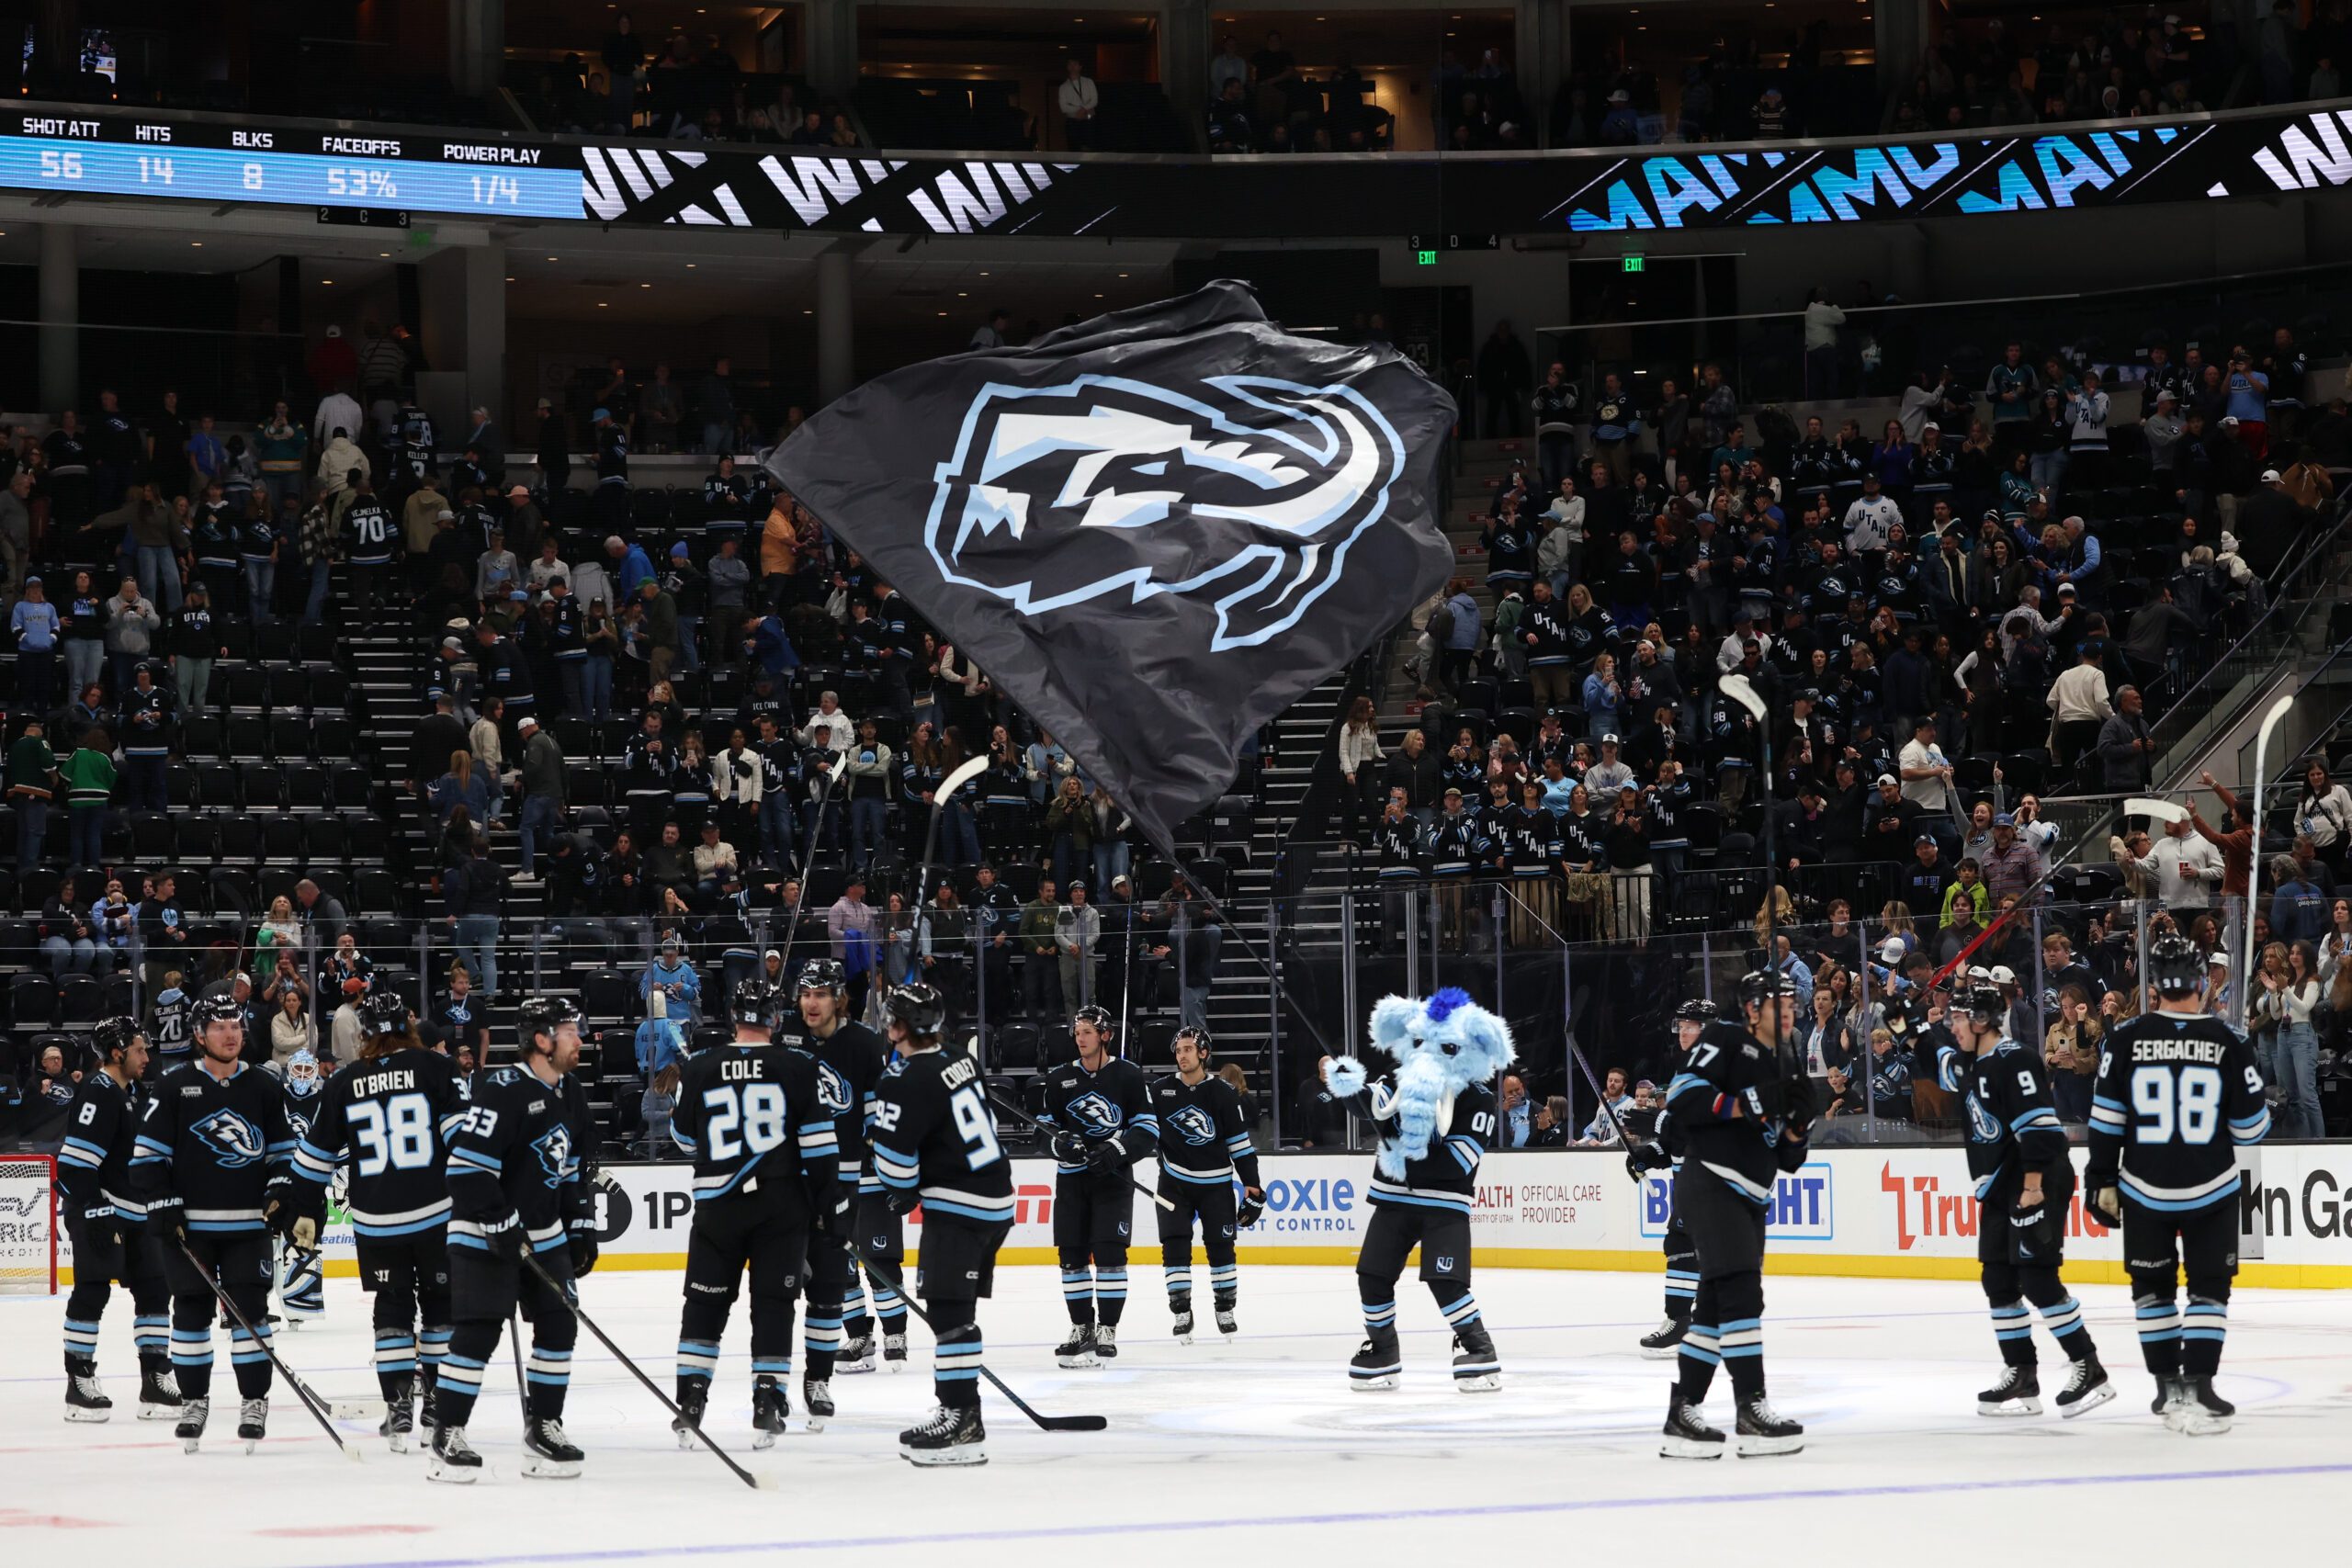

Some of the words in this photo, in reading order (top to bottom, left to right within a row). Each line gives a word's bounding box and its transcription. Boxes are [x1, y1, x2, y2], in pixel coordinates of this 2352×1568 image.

[22, 118, 66, 136] SHOT
[68, 120, 100, 138] ATT
[135, 125, 171, 142] HITS
[232, 131, 273, 148] BLKS
[322, 137, 401, 156] FACEOFFS
[444, 144, 499, 163] POWER
[501, 147, 540, 164] PLAY
[40, 151, 84, 179] 56
[137, 156, 175, 185] 14
[243, 163, 264, 190] 8
[327, 168, 397, 198] 53%
[470, 175, 521, 205] 1/4
[322, 208, 329, 221] 2
[359, 209, 368, 223] C
[398, 211, 407, 225] 3
[1411, 235, 1419, 248] 3
[1450, 235, 1459, 247] D
[1487, 234, 1497, 247] 4
[1419, 251, 1436, 265] EXIT
[1624, 257, 1643, 272] EXIT
[2004, 478, 2015, 489] 71
[352, 516, 386, 544] 70
[1859, 510, 1886, 538] UTAH
[184, 612, 210, 624] UTAH
[560, 611, 567, 621] 8
[1534, 613, 1566, 642] UTAH
[1778, 637, 1798, 661] UTAH
[435, 671, 440, 681] 9
[153, 698, 158, 707] C
[752, 702, 764, 710] ICE
[1713, 711, 1726, 723] 98
[902, 751, 909, 761] 9
[1517, 829, 1546, 858] UTAH
[1569, 825, 1592, 855] UTAH
[989, 895, 996, 904] C
[2098, 977, 2108, 992] 7
[2162, 976, 2183, 989] 98
[743, 1011, 758, 1022] 28
[159, 1013, 183, 1043] 70
[379, 1021, 392, 1033] 38
[1686, 1042, 1721, 1068] 17
[2132, 1039, 2227, 1066] SERGACHEV
[720, 1059, 763, 1081] COLE
[353, 1069, 415, 1100] O'BRIEN
[1978, 1076, 1991, 1100] C
[2017, 1069, 2037, 1096] 9
[78, 1101, 96, 1126] 8
[1617, 1109, 1623, 1119] C
[2130, 1065, 2223, 1145] 98
[463, 1105, 500, 1139] 53
[701, 1082, 787, 1162] 28
[874, 1098, 902, 1133] 92
[949, 1078, 1005, 1173] 9
[1471, 1111, 1496, 1138] 00
[345, 1092, 435, 1178] 38
[1521, 1185, 1570, 1201] OFFICIAL
[1573, 1185, 1602, 1201] CARE
[1276, 1218, 1356, 1232] CONTROL
[1490, 1213, 1498, 1224] OF
[1498, 1214, 1514, 1224] UTAH
[1521, 1207, 1577, 1224] PROVIDER
[2130, 1258, 2173, 1269] BAUER
[690, 1281, 729, 1294] BAUER
